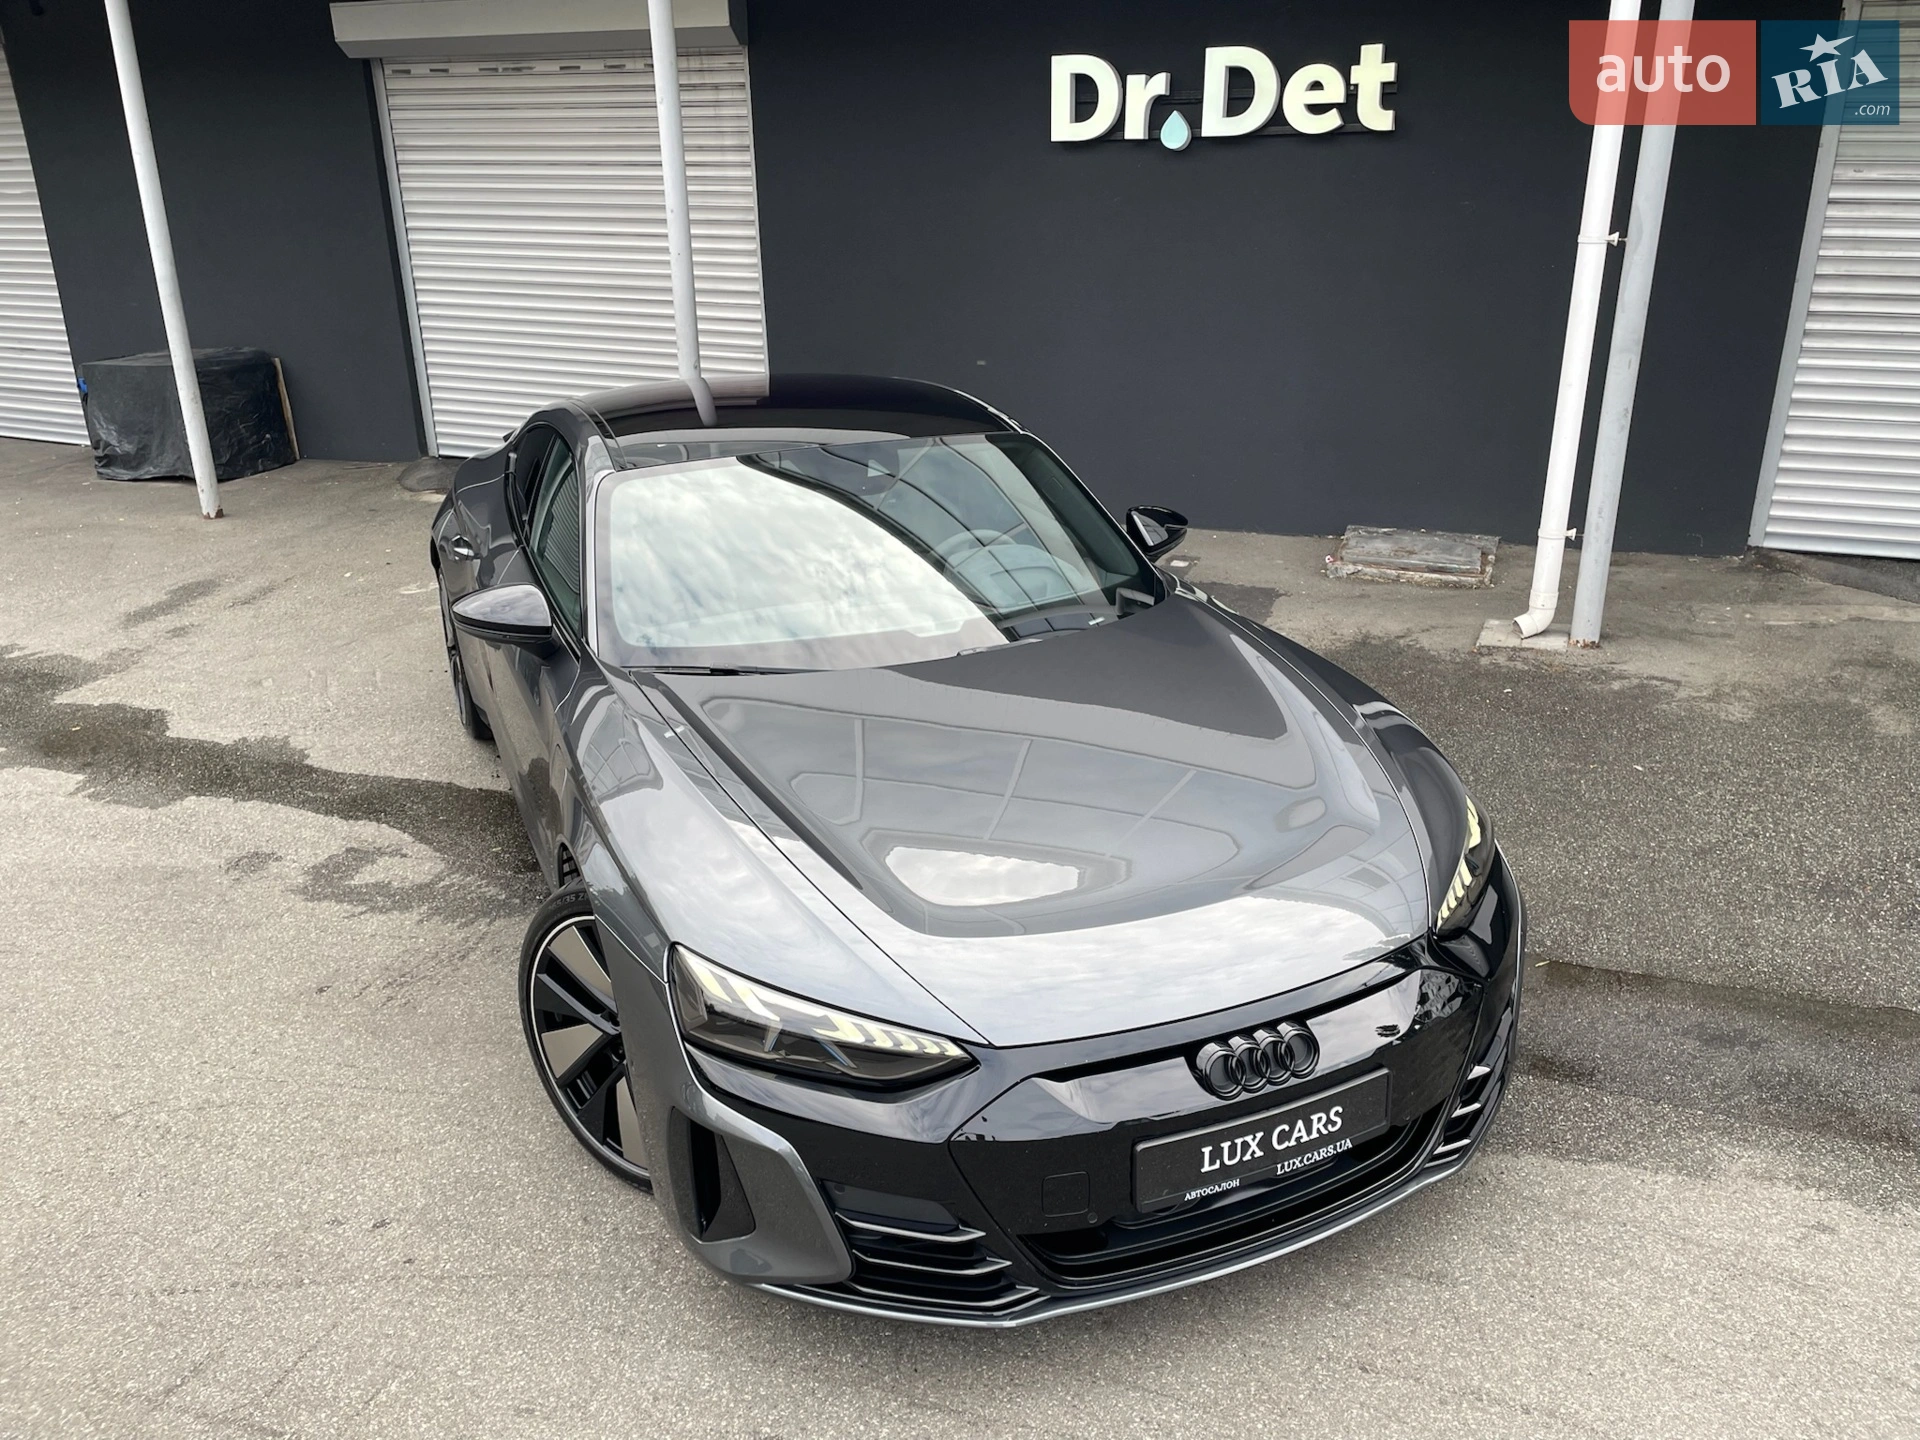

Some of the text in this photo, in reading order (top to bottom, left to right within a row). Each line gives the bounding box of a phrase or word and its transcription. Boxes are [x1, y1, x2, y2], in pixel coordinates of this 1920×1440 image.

[1200, 1105, 1344, 1173] LUX CARS
[1276, 1138, 1353, 1175] LUX.CARS.UA
[1184, 1178, 1241, 1201] АВТОСАЛОН
